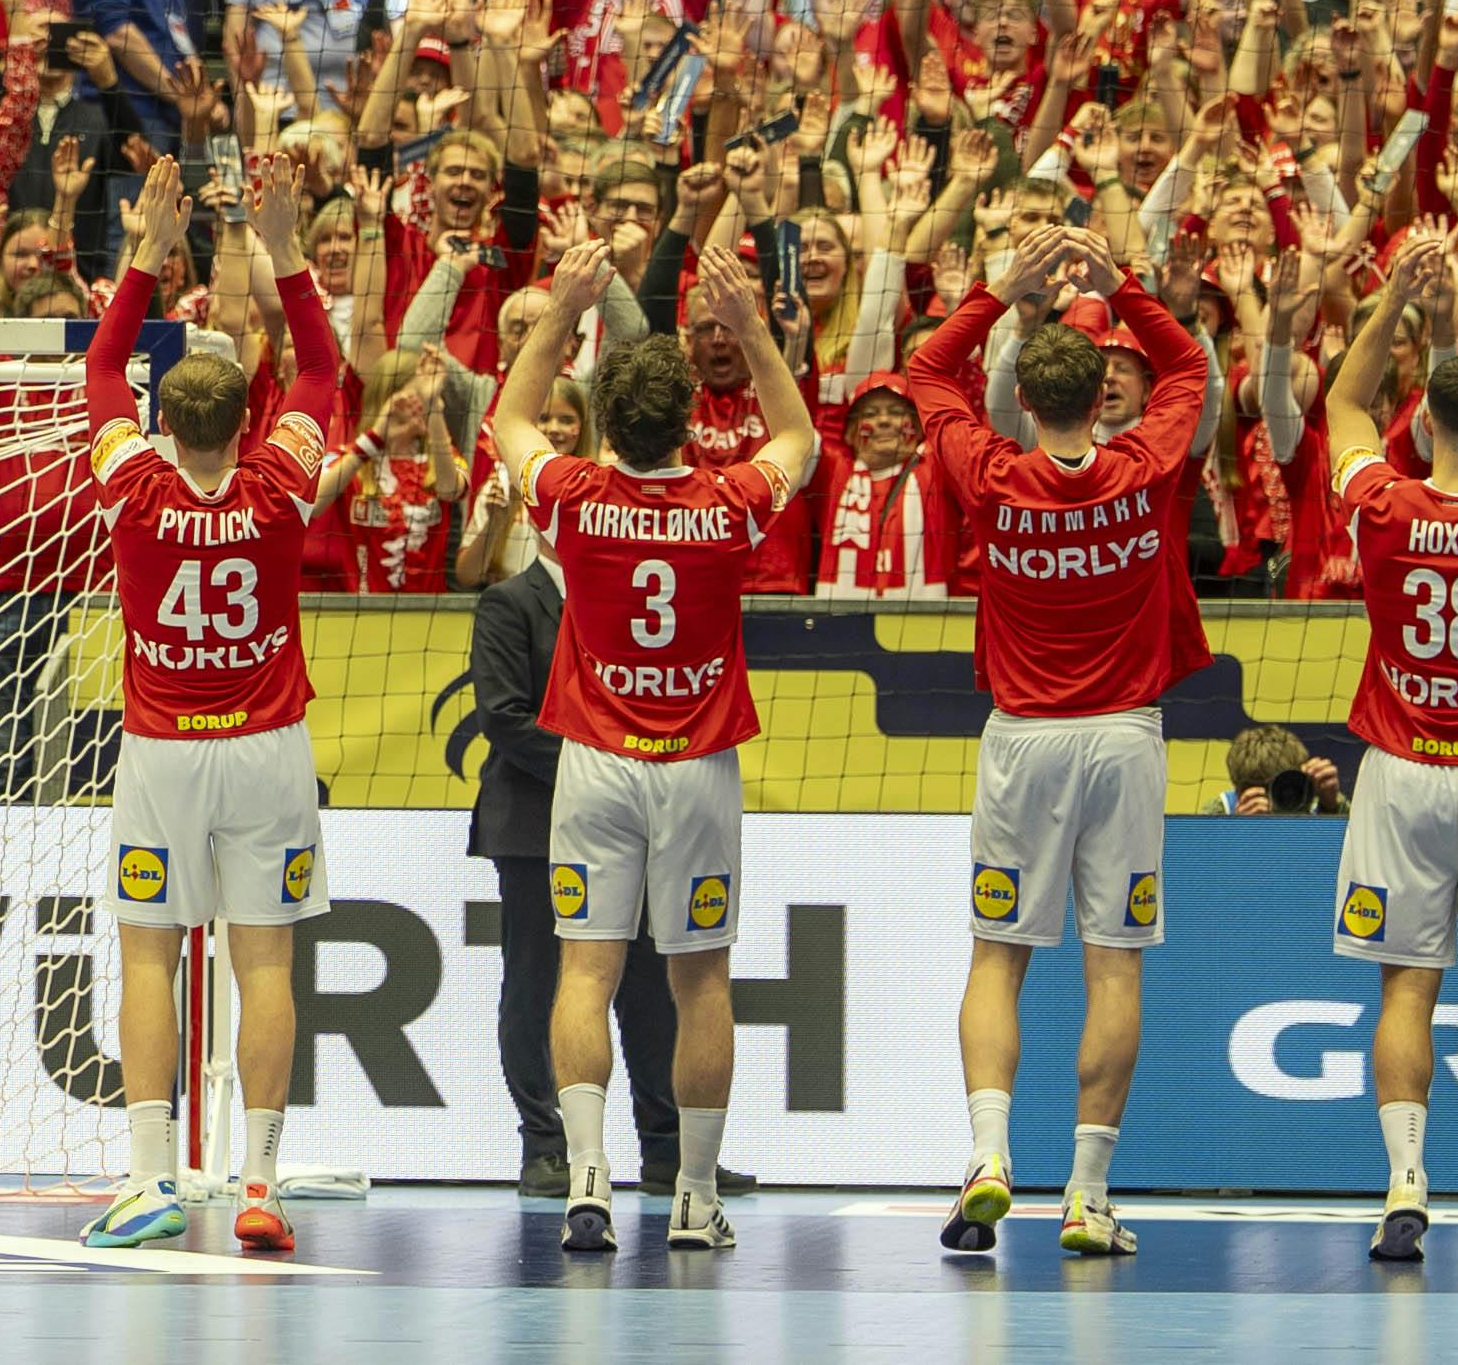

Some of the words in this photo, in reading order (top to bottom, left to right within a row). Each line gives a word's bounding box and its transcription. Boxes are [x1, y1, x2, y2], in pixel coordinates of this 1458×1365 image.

[156, 507, 262, 546] PYTLICK
[577, 501, 733, 542] KIRKELØKKE
[996, 488, 1152, 534] DANMARK
[988, 529, 1161, 580] NORLYS
[157, 557, 259, 641] 43
[630, 559, 677, 649] 3
[176, 710, 249, 731] BORUP
[622, 734, 690, 754] BORUP
